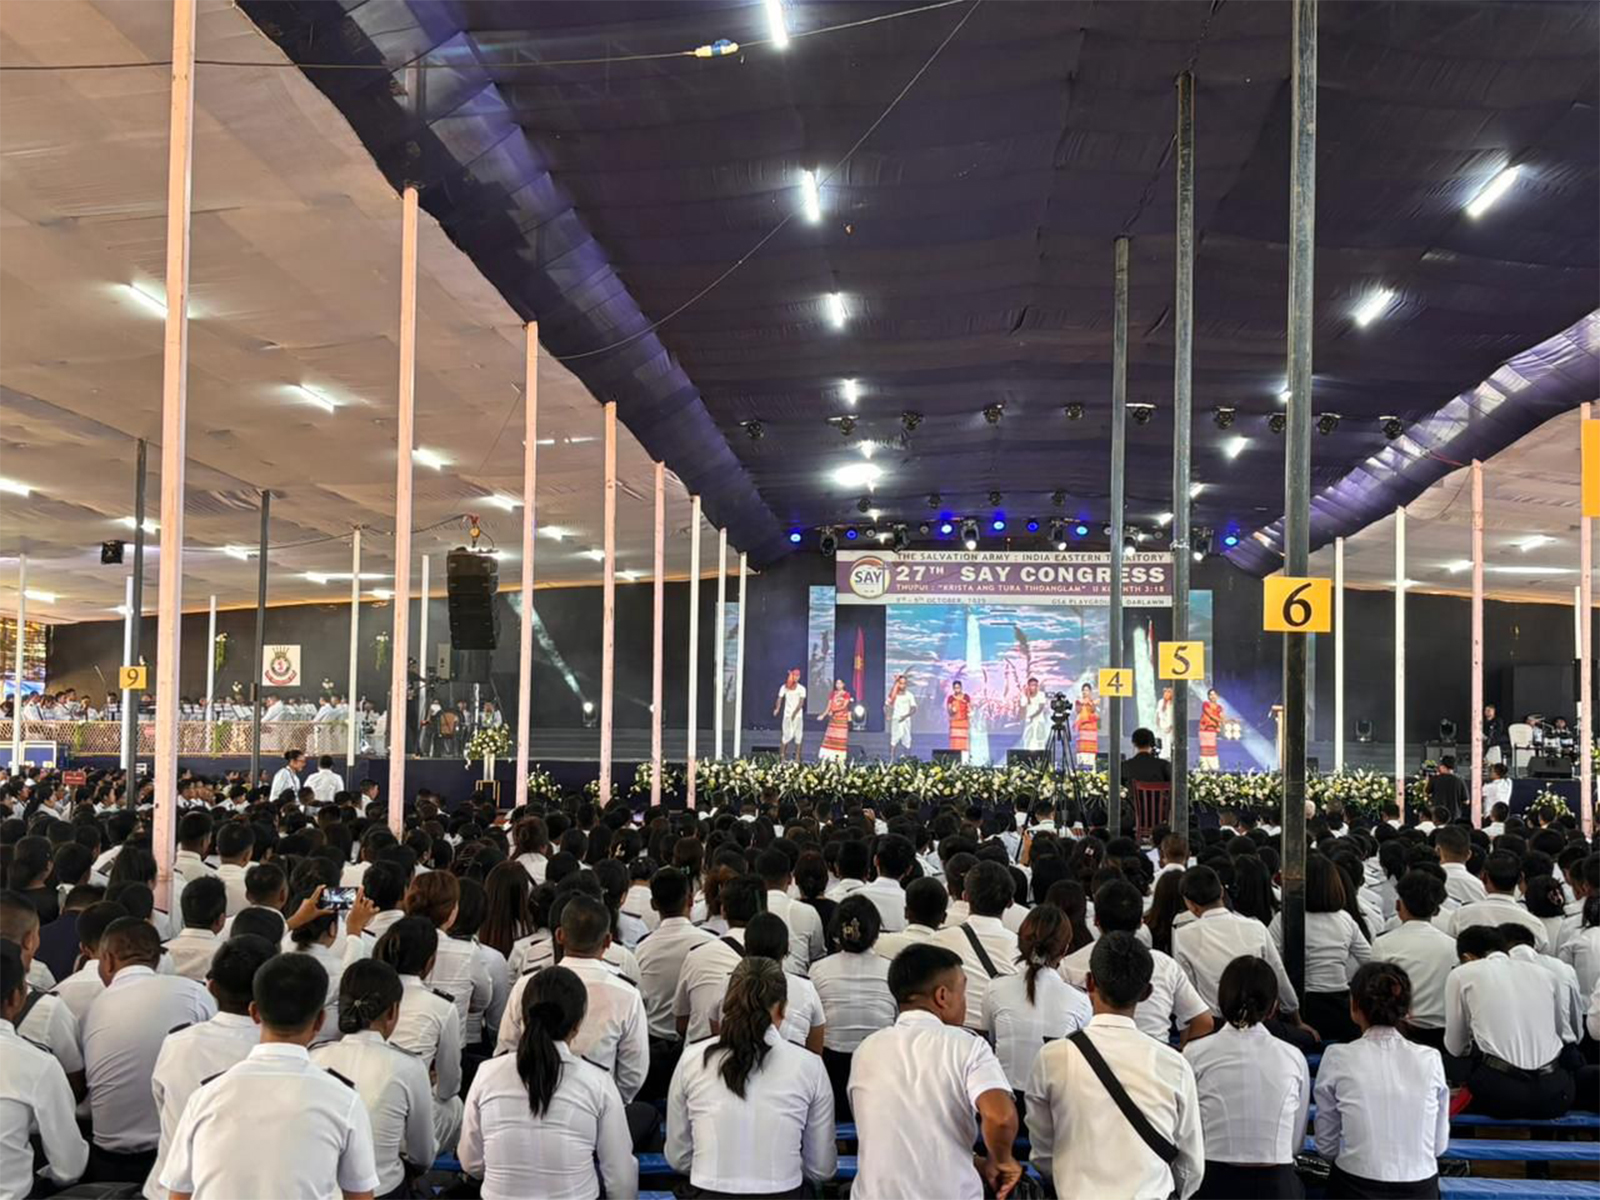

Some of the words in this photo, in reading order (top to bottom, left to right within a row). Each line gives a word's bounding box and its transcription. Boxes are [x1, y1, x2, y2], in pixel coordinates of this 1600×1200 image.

[897, 553, 915, 561] THE
[920, 553, 978, 561] SALVATION
[981, 553, 1010, 561] ARMY
[1022, 553, 1050, 561] INDIA
[1054, 553, 1101, 561] EASTERN
[1106, 553, 1165, 562] TRITORY
[855, 567, 882, 583] SAY
[960, 565, 1011, 582] SAY
[976, 584, 995, 592] ANG
[998, 584, 1021, 592] TURA
[1282, 581, 1313, 628] 6
[1171, 645, 1191, 676] 5
[126, 668, 139, 687] 9
[1106, 670, 1124, 694] 4
